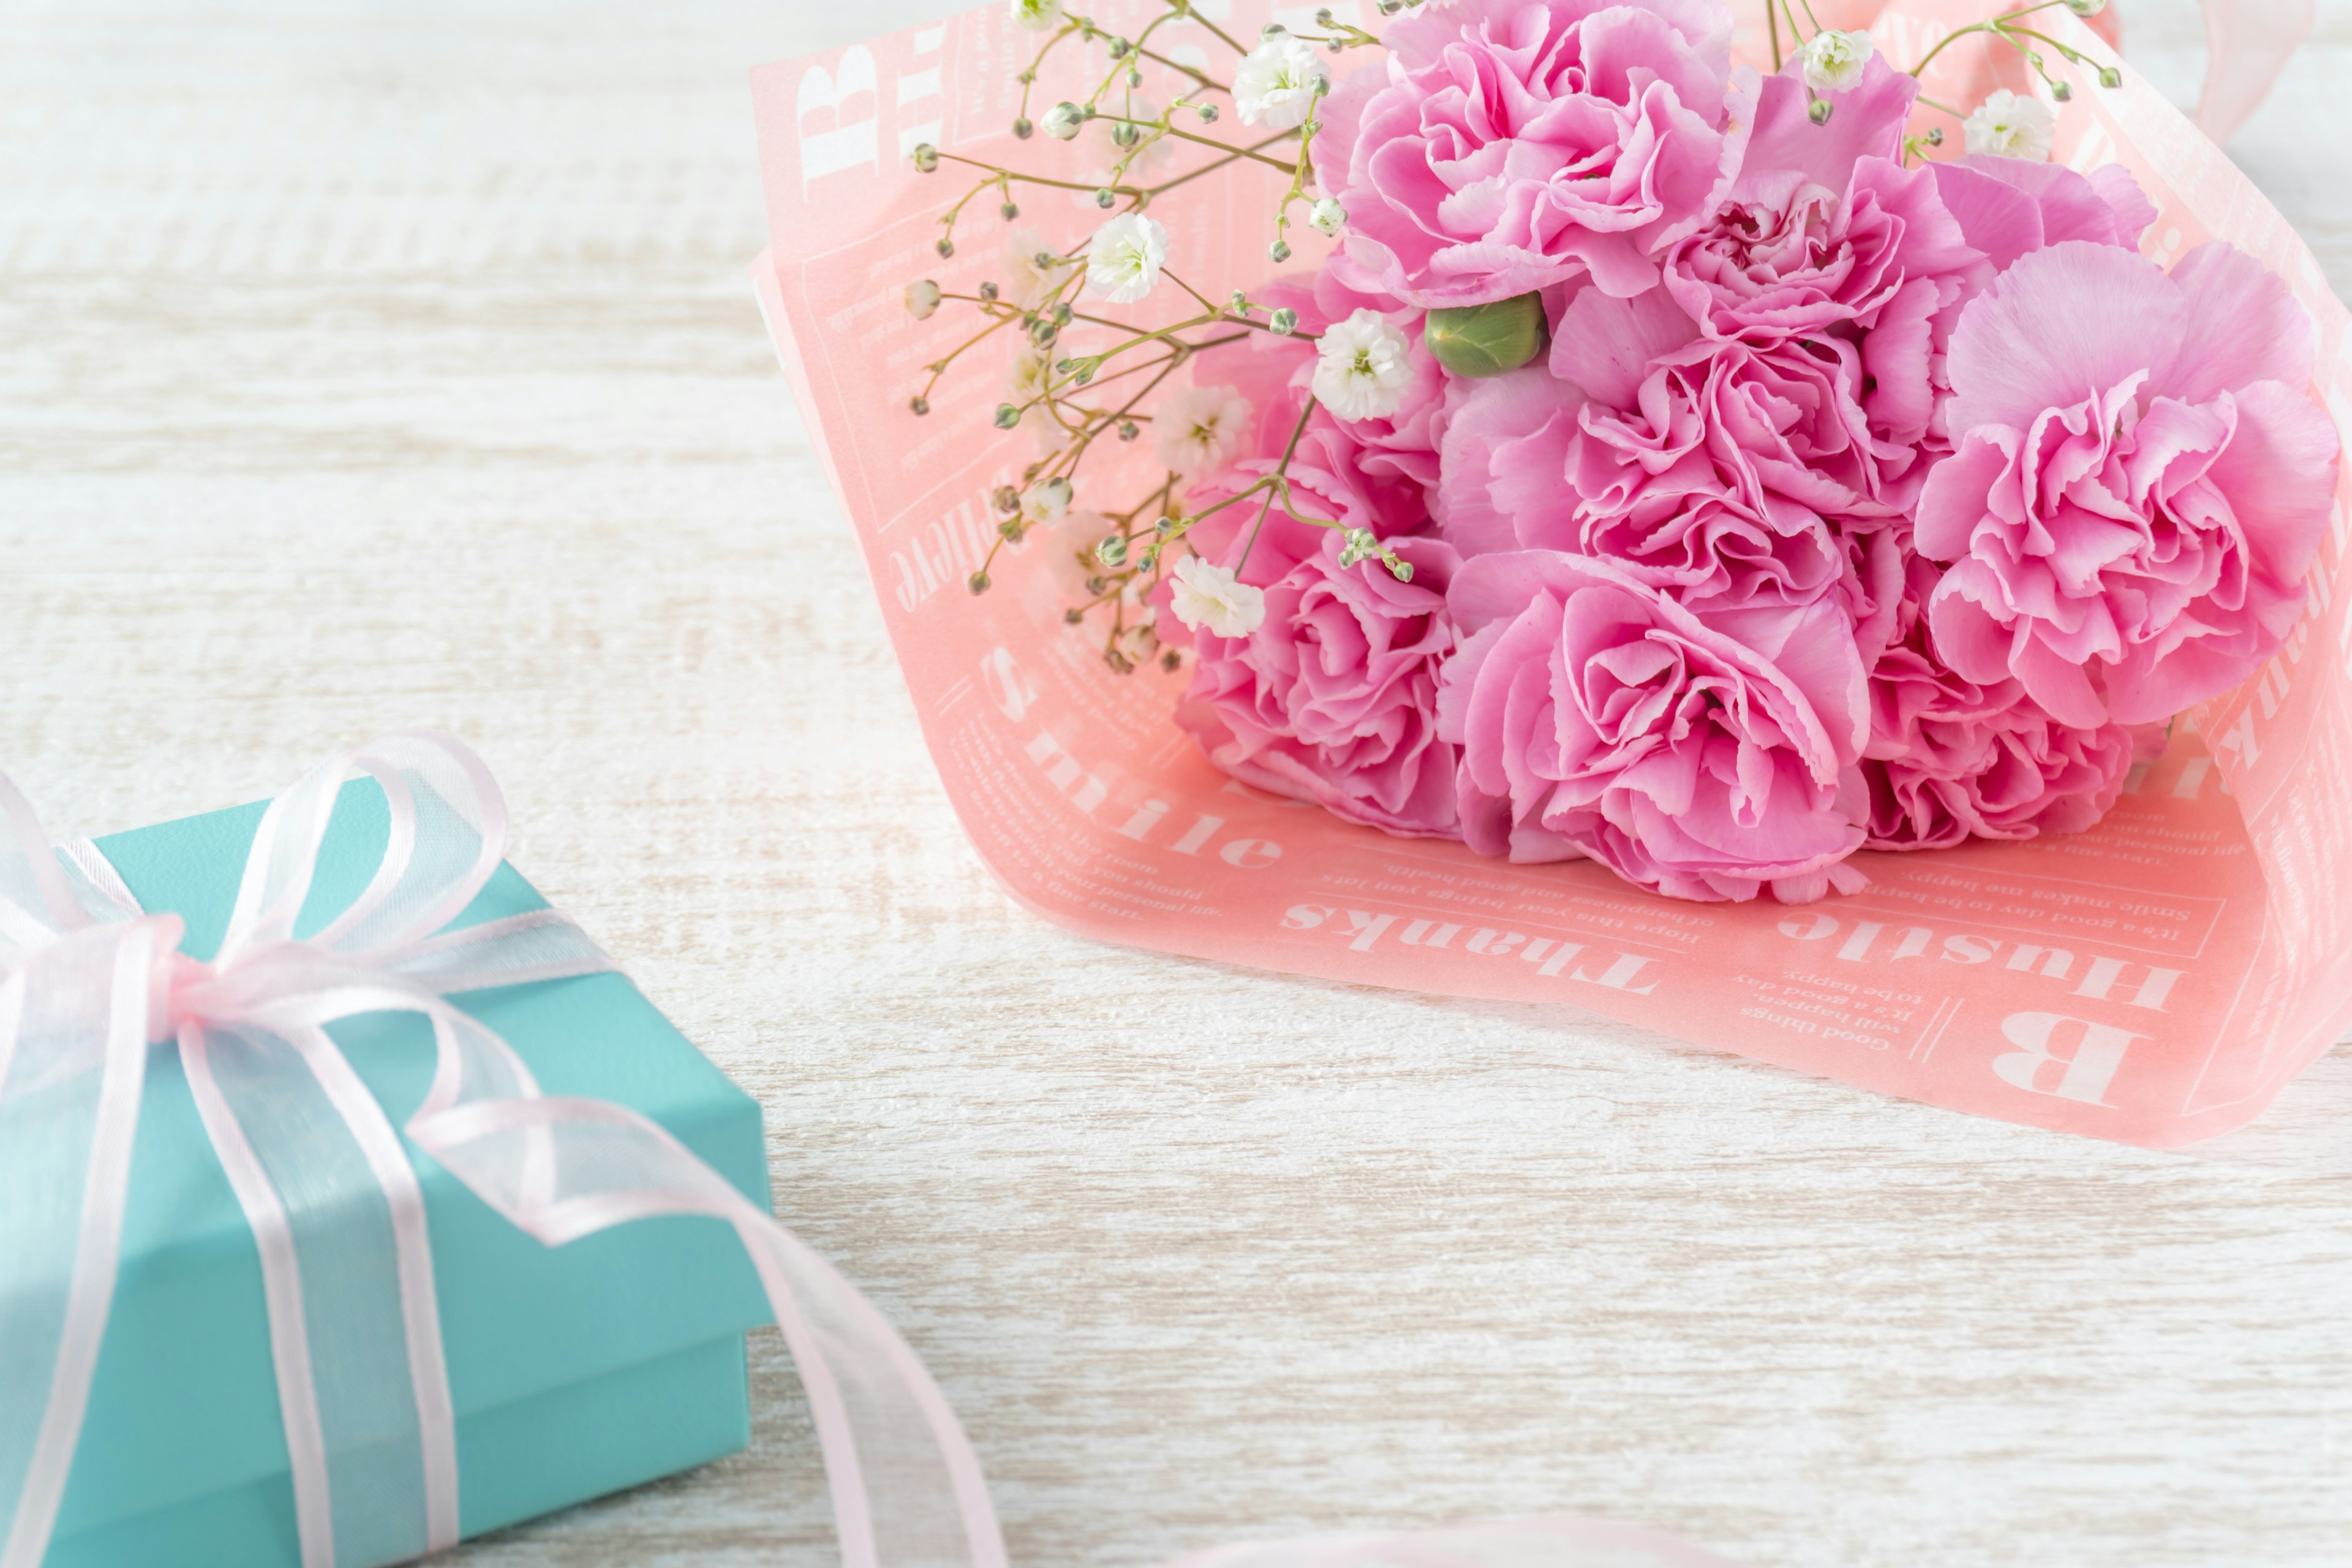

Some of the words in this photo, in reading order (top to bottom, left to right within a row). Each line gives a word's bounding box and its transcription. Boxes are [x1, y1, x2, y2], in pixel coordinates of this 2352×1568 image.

[798, 45, 878, 201] B
[889, 486, 1023, 613] elieve
[979, 646, 1283, 869] Smile
[2111, 812, 2166, 823] room
[2146, 827, 2220, 841] should
[1070, 829, 1101, 854] the
[1104, 854, 1159, 875] room
[2065, 845, 2104, 856] fine
[2111, 853, 2168, 866] start.
[2116, 838, 2207, 856] personal
[992, 797, 1007, 816] to
[1007, 818, 1054, 867] enrich
[1055, 867, 1098, 889] your
[1098, 887, 1186, 911] personal
[1189, 906, 1222, 917] life.
[990, 824, 1014, 847] off
[1012, 850, 1030, 867] to
[1032, 872, 1042, 882] a
[1047, 881, 1084, 902] fine
[1088, 901, 1143, 920] start.
[1052, 842, 1088, 867] and
[1091, 865, 1128, 883] you
[1133, 880, 1204, 900] should
[1383, 863, 1456, 885] health.
[1320, 874, 1368, 889] lots
[1374, 881, 1422, 894] you
[1460, 878, 1520, 892] good
[1899, 870, 1980, 894] happy.
[1986, 884, 2024, 896] me
[1426, 889, 1505, 910] brings
[1520, 887, 1565, 899] and
[1865, 882, 1929, 904] happ
[2032, 889, 2112, 908] makes
[1512, 903, 1569, 917] year
[1570, 896, 1685, 924] happiness
[1934, 897, 1963, 909] be
[1969, 901, 1993, 911] to
[1999, 905, 2045, 919] day
[2120, 903, 2191, 921] Smile
[1577, 913, 1624, 928] this
[1686, 917, 1715, 927] of
[2051, 913, 2117, 928] good
[1634, 924, 1701, 944] Hope
[2143, 927, 2180, 940] It's
[1278, 903, 1662, 997] Thanks
[1776, 911, 2192, 1013] Hustle
[1730, 974, 1777, 990] day
[1783, 969, 1858, 994] happy.
[1783, 987, 1849, 1005] good
[1863, 988, 1893, 1001] be
[1897, 994, 1922, 1005] to
[1753, 993, 1850, 1023] happen.
[1874, 1007, 1913, 1022] It's
[1740, 1008, 1817, 1033] things
[1854, 1017, 1900, 1034] will
[1821, 1027, 1890, 1050] Good
[1992, 1011, 2155, 1109] B
